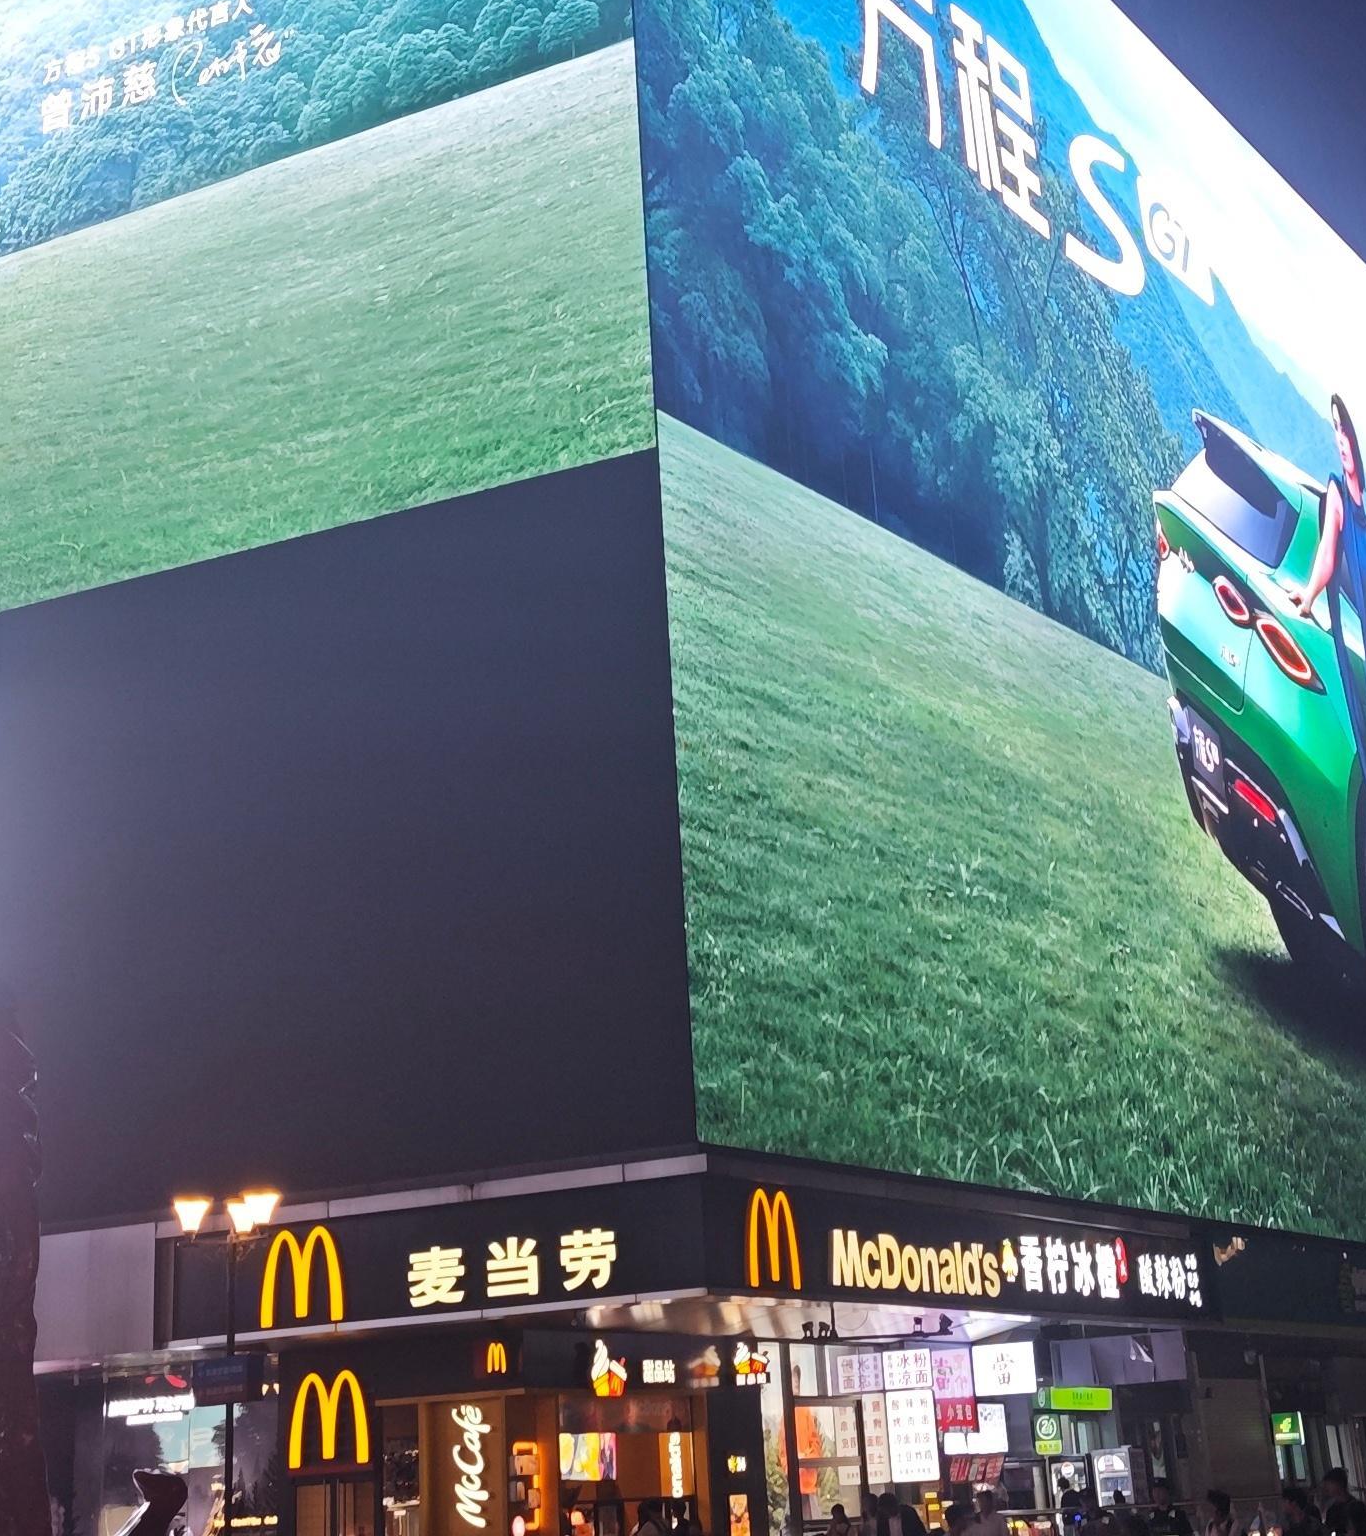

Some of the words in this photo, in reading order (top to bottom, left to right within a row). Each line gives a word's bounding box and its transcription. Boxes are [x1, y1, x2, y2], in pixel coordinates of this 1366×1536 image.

[408, 1227, 617, 1307] 麦当劳
[831, 1228, 1000, 1298] McDonald's
[453, 1402, 493, 1529] McCafé
